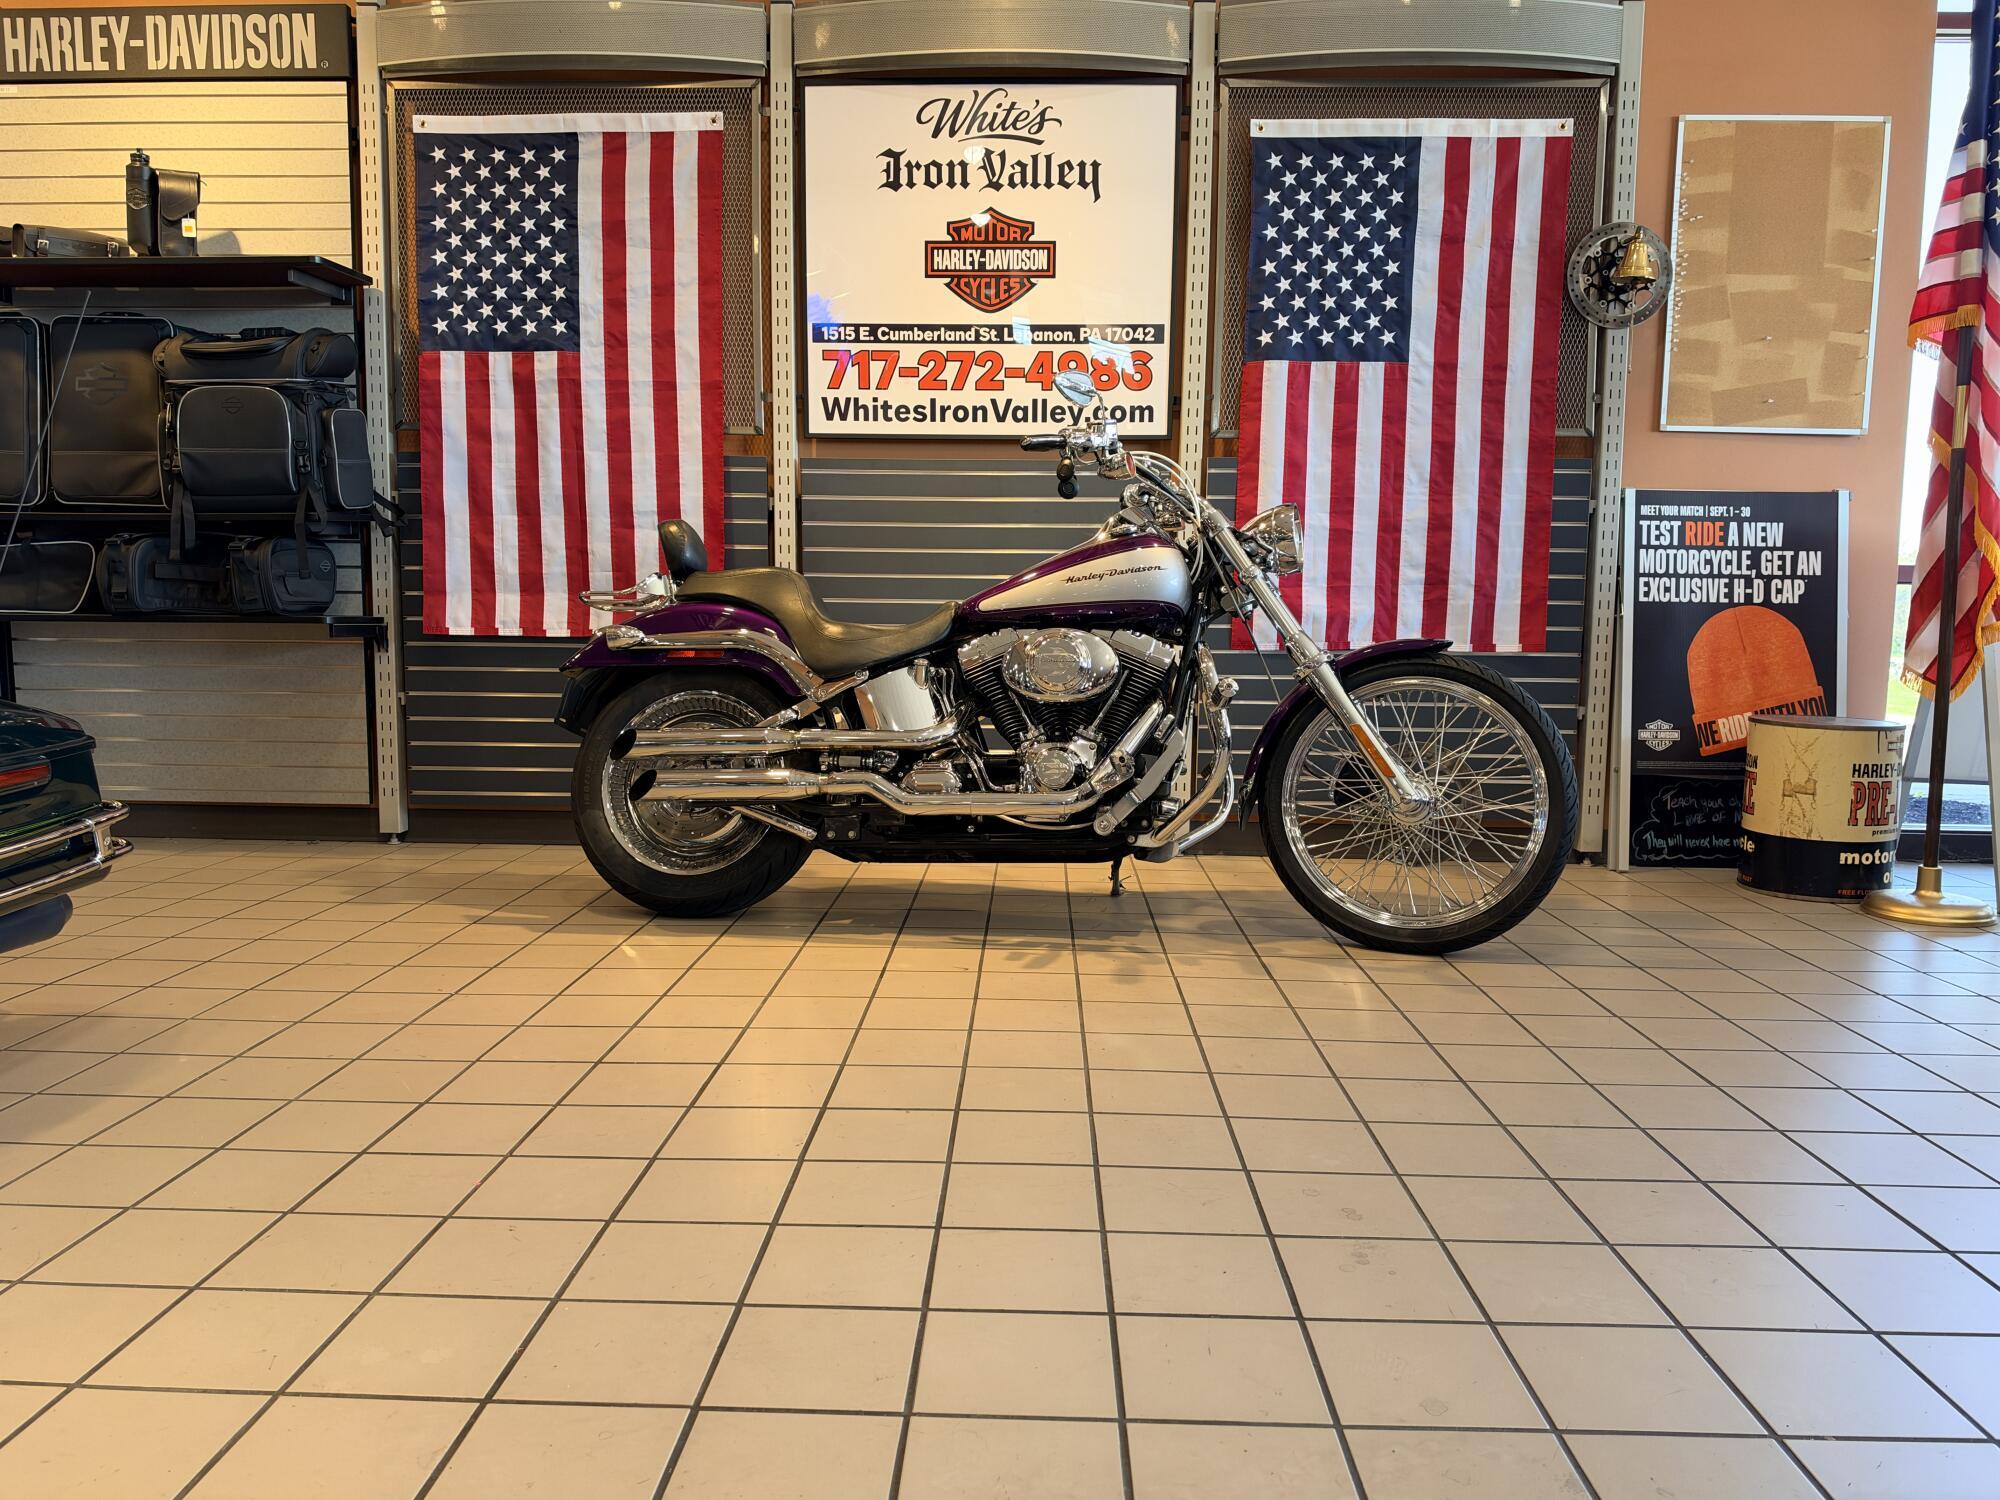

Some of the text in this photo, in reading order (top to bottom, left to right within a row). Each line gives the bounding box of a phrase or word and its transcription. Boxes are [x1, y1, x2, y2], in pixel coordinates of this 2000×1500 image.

[3, 13, 317, 72] HARLEY-DAVIDSON
[915, 87, 1063, 142] White's
[876, 147, 1102, 203] Iron Valley
[961, 214, 1021, 241] MOTOR
[933, 249, 1047, 271] HARLEY-DAVIDSON
[960, 278, 1021, 305] CYCLES
[821, 326, 1155, 343] 1515 E. Cumberland St. Lanon, PA 17042
[821, 396, 1154, 426] WhitesIronValley.com
[1640, 505, 1659, 516] MEET
[1660, 505, 1679, 516] YOUR
[1680, 505, 1704, 517] MATCH
[1709, 506, 1729, 517] SEPT.
[1740, 507, 1751, 517] 30
[1639, 520, 1784, 547] TEST RIDE A NEW
[1060, 565, 1168, 584] Harley-Davidson
[1639, 548, 1822, 577] MOTORCYCLE, GET AN
[1638, 577, 1729, 603] EXCLUSIVE
[1733, 578, 1765, 604] H-D
[1847, 781, 1899, 827] PRE-
